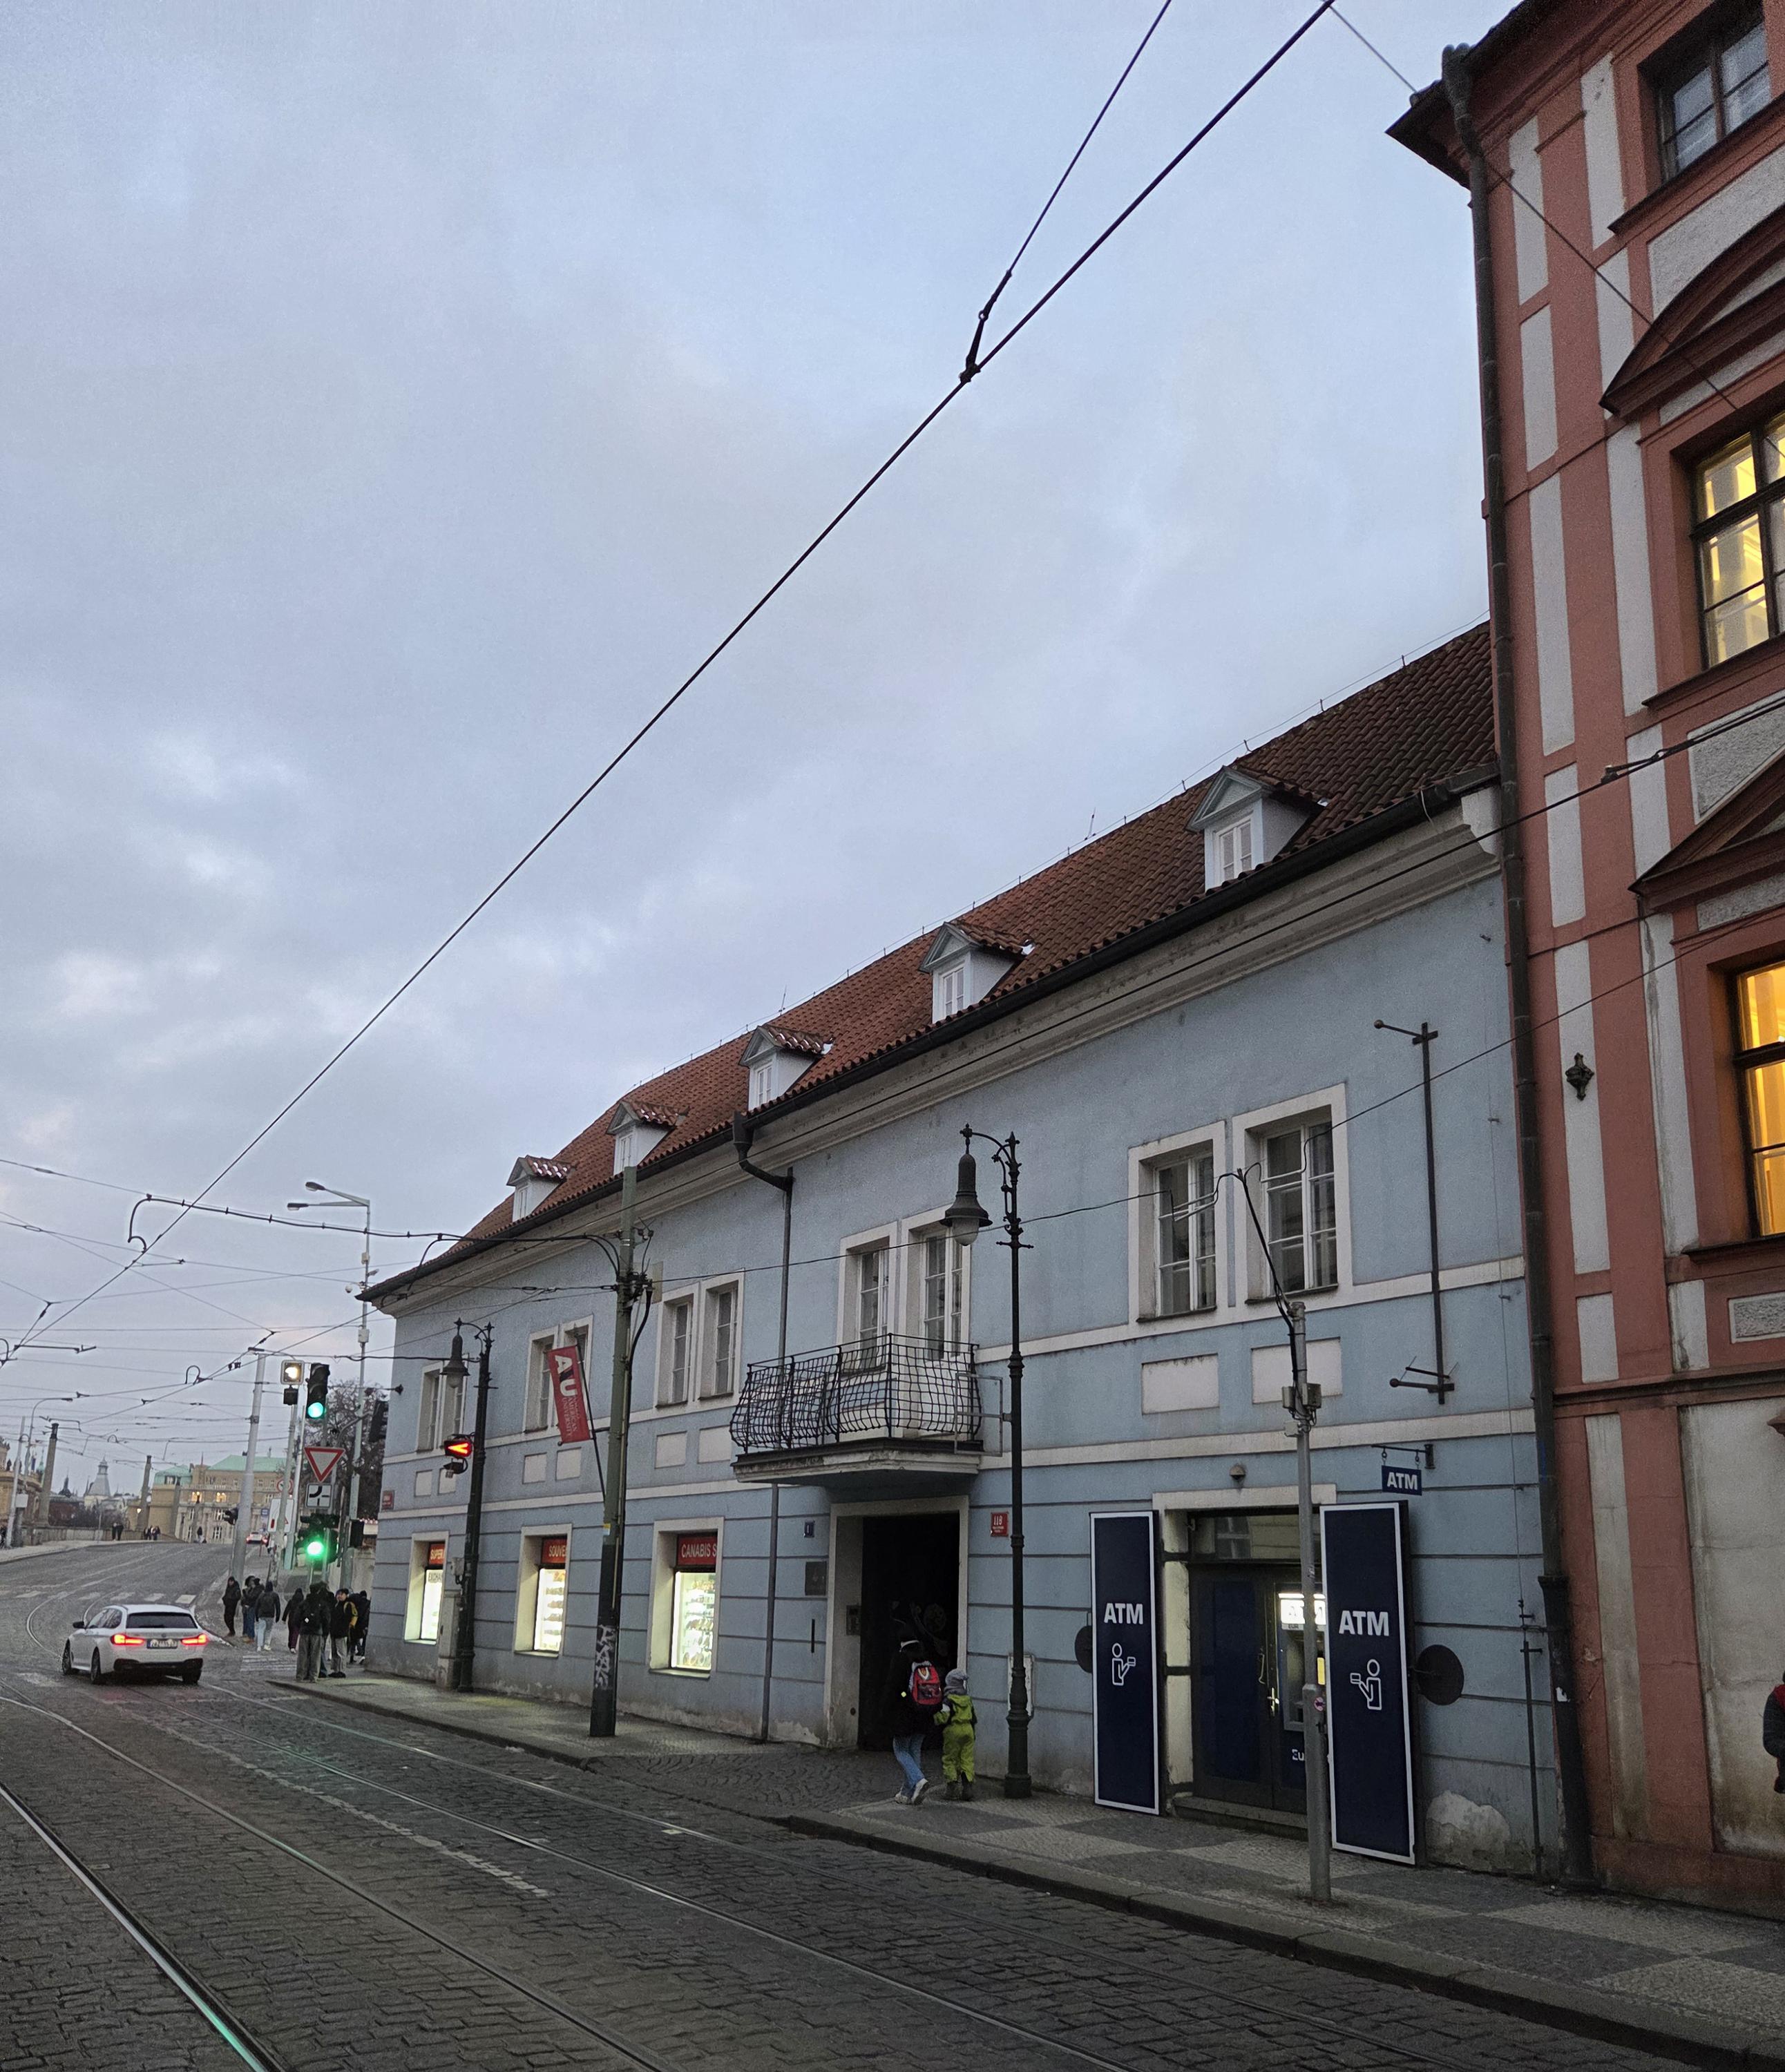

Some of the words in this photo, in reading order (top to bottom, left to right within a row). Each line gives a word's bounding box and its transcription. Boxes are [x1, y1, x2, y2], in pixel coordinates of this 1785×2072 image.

[1386, 1472, 1418, 1490] ATM
[993, 1515, 1003, 1526] 118
[681, 1544, 711, 1557] CANABIS
[1103, 1602, 1144, 1624] ATM
[1338, 1610, 1390, 1637] ATM
